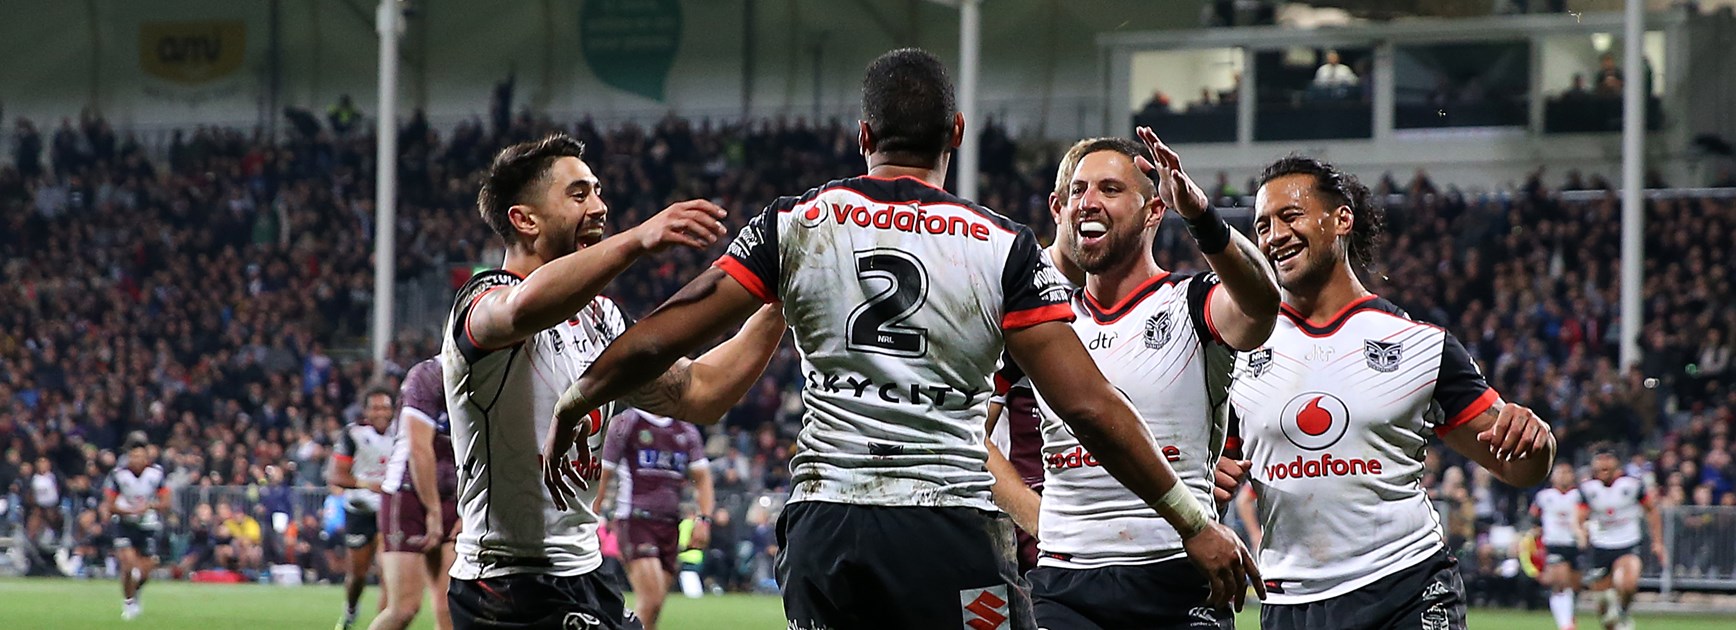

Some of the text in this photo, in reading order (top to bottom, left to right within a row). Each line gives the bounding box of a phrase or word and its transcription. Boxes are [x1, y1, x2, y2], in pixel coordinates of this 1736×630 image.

[831, 203, 990, 241] vodafone
[845, 247, 929, 359] 2
[877, 335, 895, 344] NRL
[1088, 331, 1115, 351] dtr
[1251, 350, 1270, 362] NRL
[808, 370, 979, 406] SKYCITY
[1265, 454, 1383, 481] vodafone
